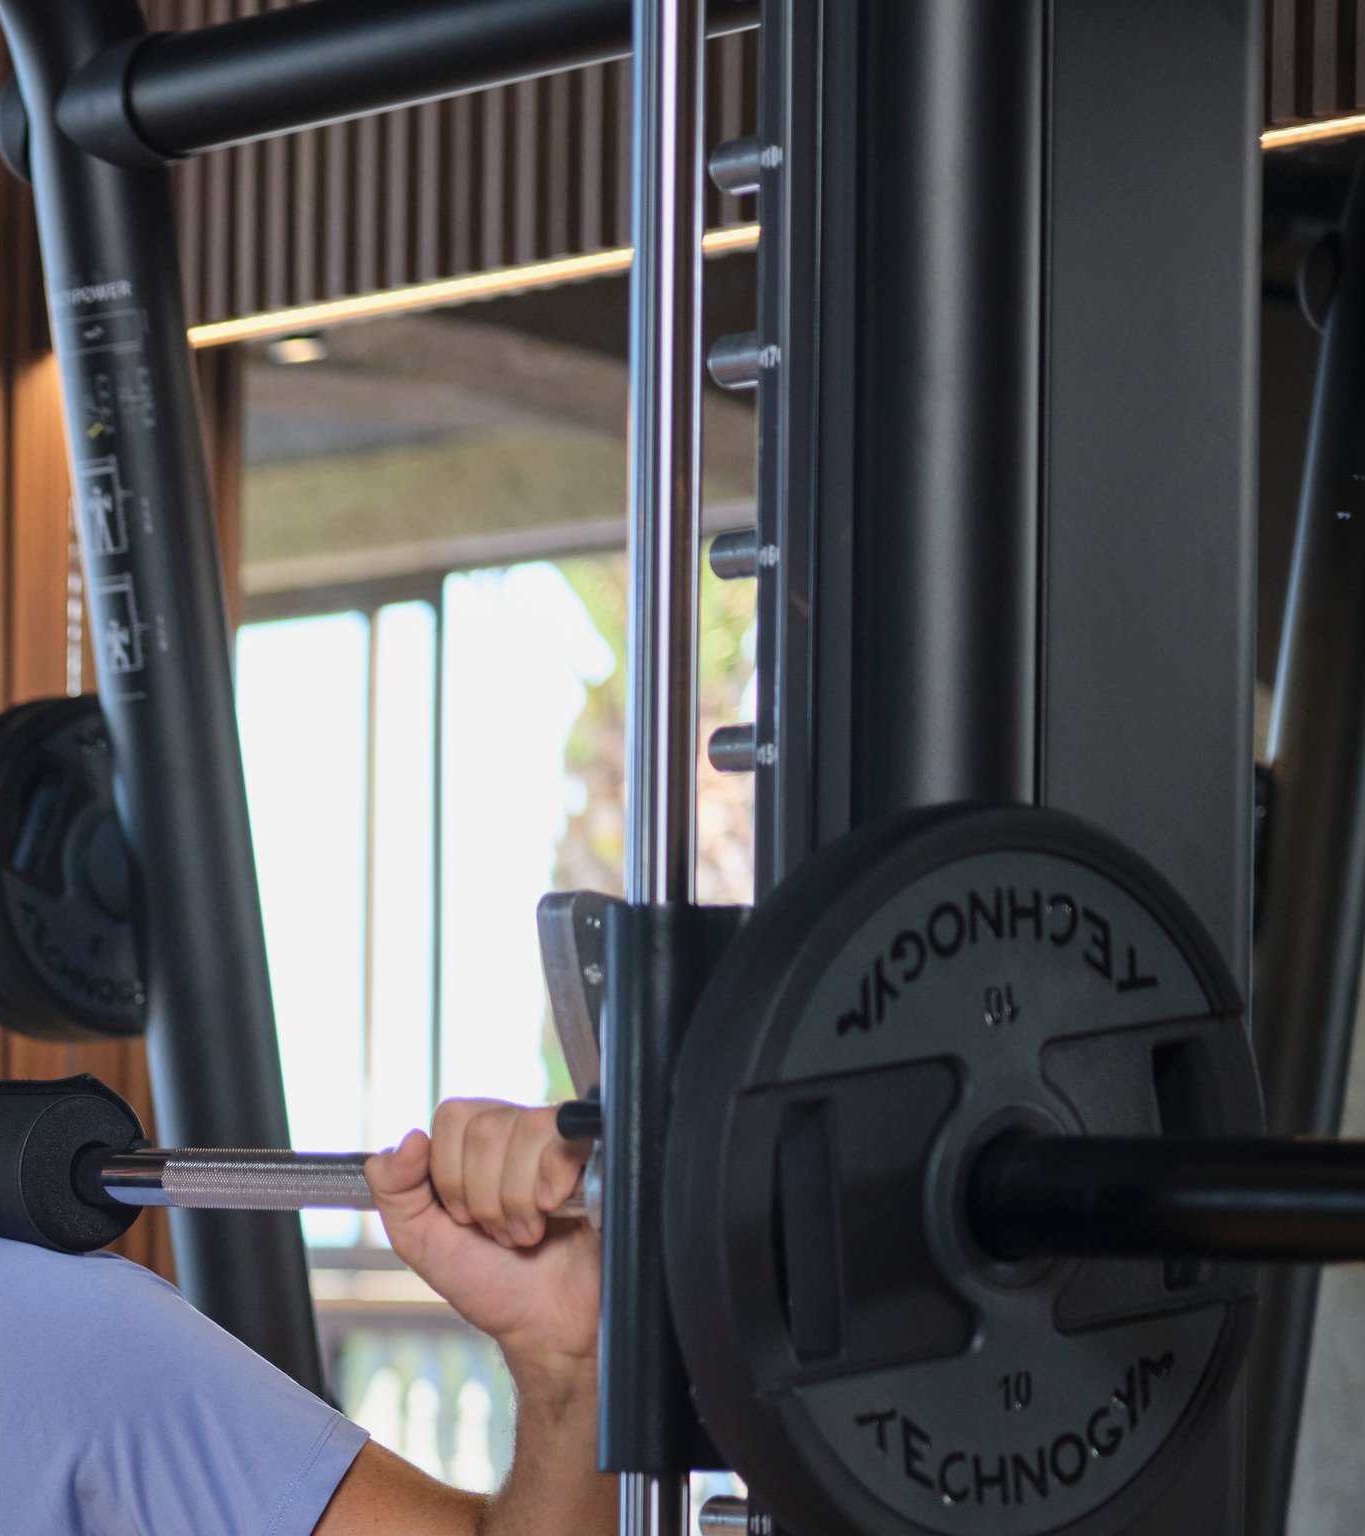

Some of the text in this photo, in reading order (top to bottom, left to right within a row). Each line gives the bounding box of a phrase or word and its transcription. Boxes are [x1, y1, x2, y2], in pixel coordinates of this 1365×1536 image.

[836, 888, 1157, 1036] TECHNOGYM
[855, 1351, 1175, 1506] TECHNOGYM
[1000, 1371, 1032, 1409] 10
